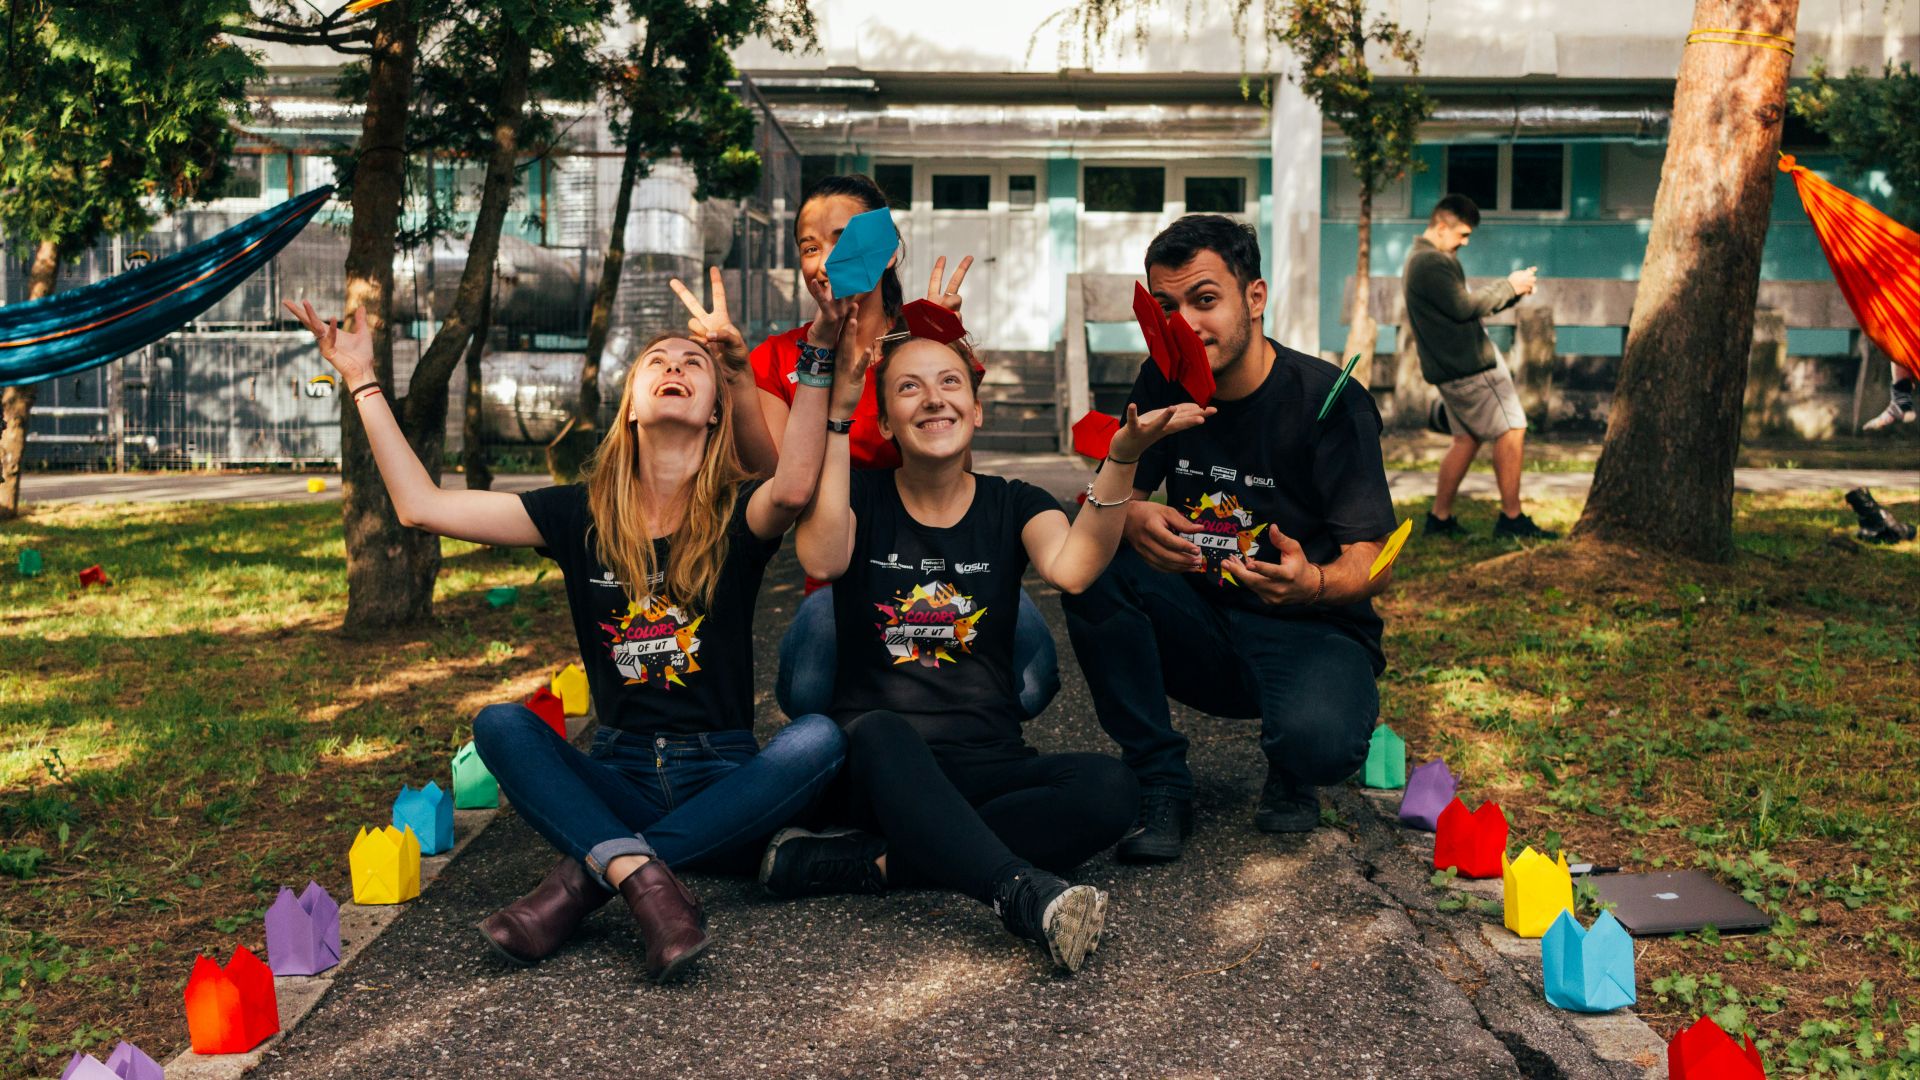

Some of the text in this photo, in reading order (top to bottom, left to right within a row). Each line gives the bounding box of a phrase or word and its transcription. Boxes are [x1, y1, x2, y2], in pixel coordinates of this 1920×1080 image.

[1201, 536, 1230, 547] OF UT
[905, 611, 956, 623] COLORS
[626, 623, 675, 639] COLORS
[913, 628, 946, 636] OF UT
[637, 640, 668, 653] OF UT
